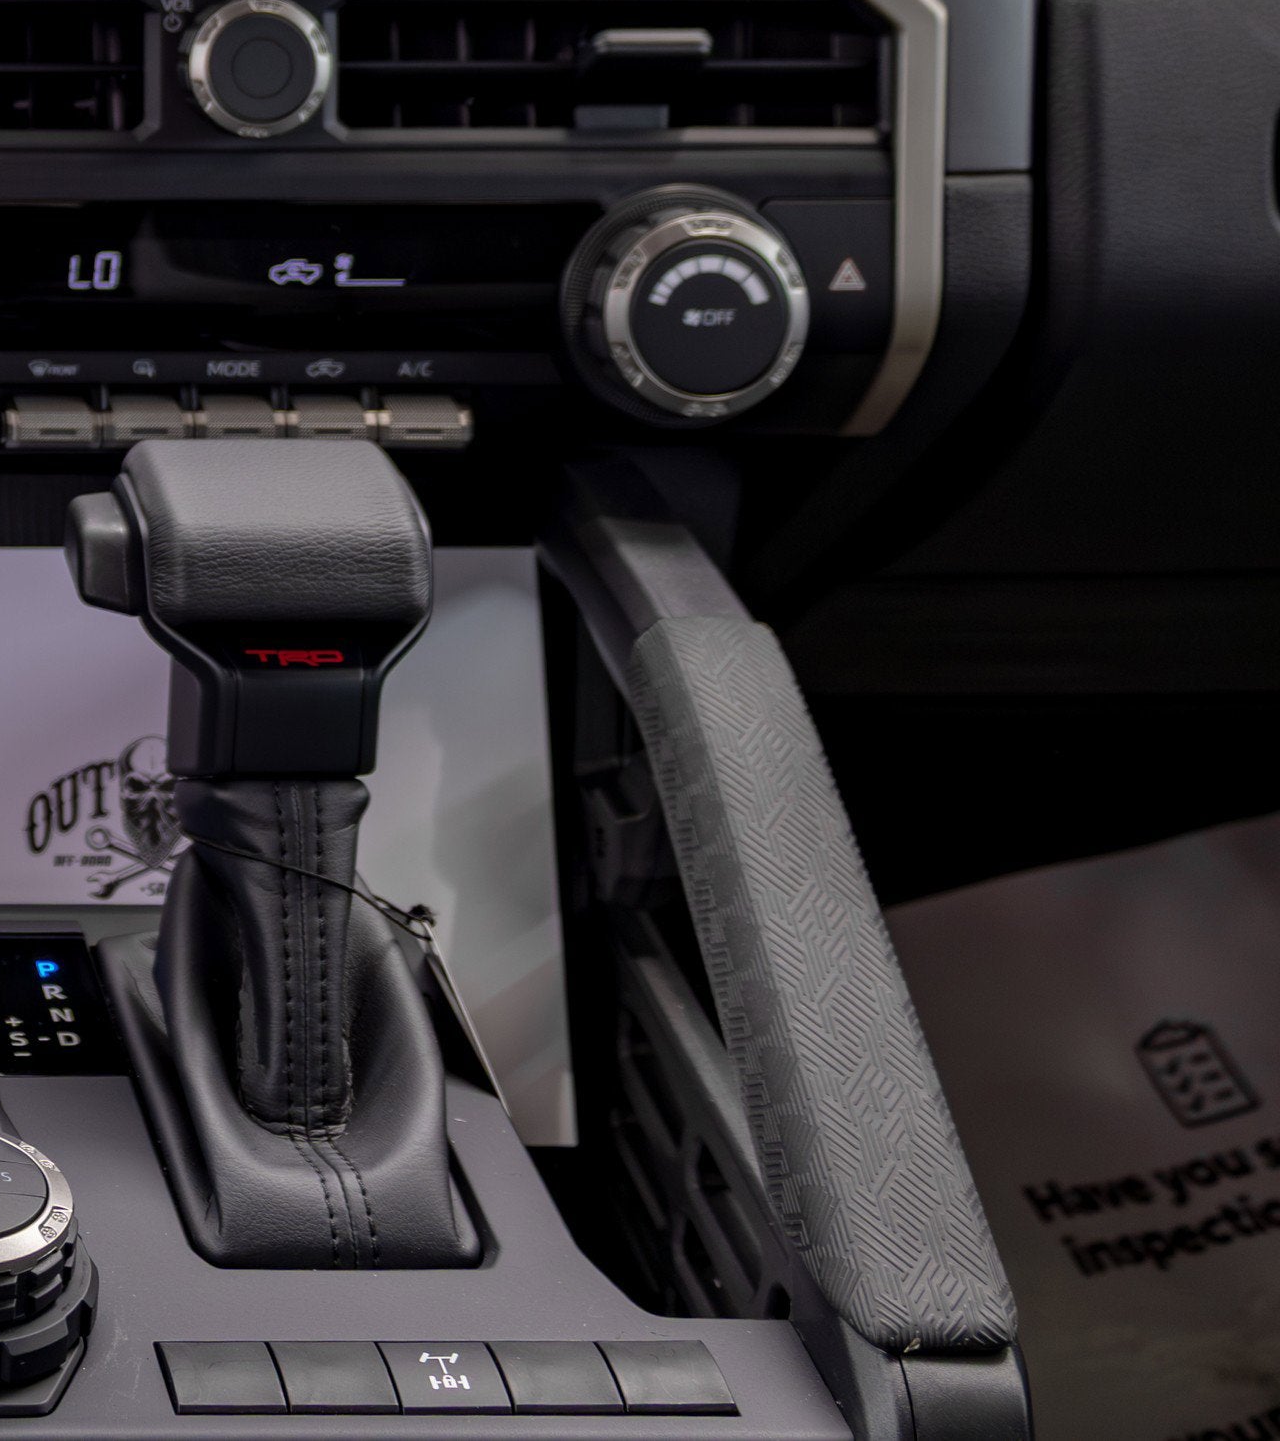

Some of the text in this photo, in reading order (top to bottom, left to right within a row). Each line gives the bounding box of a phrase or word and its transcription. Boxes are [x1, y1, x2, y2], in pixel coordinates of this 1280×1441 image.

[68, 250, 123, 290] LO
[702, 311, 736, 327] OFF
[206, 361, 262, 378] MODE
[397, 361, 435, 378] A/C
[244, 650, 345, 667] TRD
[35, 960, 59, 978] P
[41, 983, 68, 1001] R
[49, 1008, 76, 1024] N
[8, 1031, 82, 1047] S D
[1023, 1177, 1154, 1222] Have
[1155, 1148, 1252, 1206] you
[1061, 1195, 1280, 1277] inspectio
